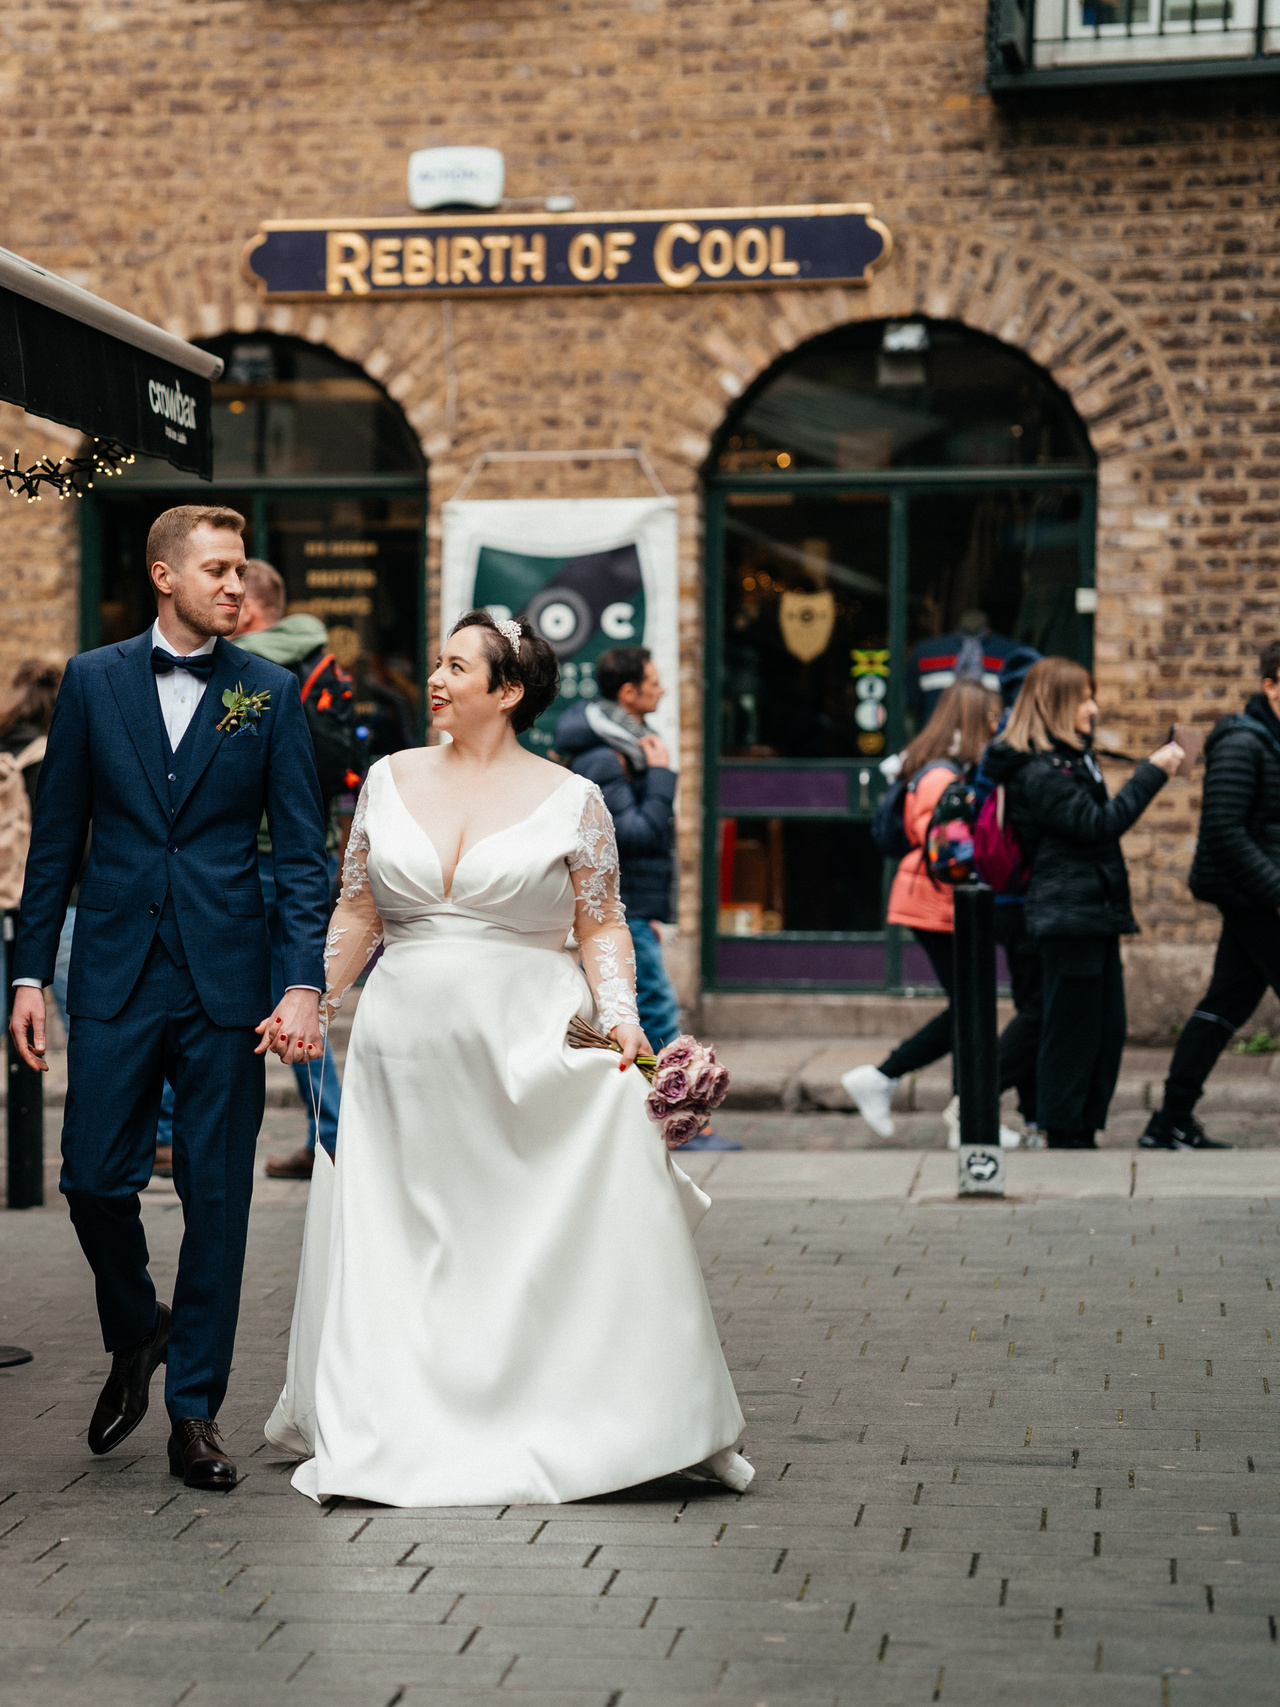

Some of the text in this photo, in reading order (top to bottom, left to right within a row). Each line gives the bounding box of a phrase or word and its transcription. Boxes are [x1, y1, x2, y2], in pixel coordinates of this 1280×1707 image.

[325, 221, 800, 296] REBIRTH OF COOL
[148, 379, 197, 430] crowbar
